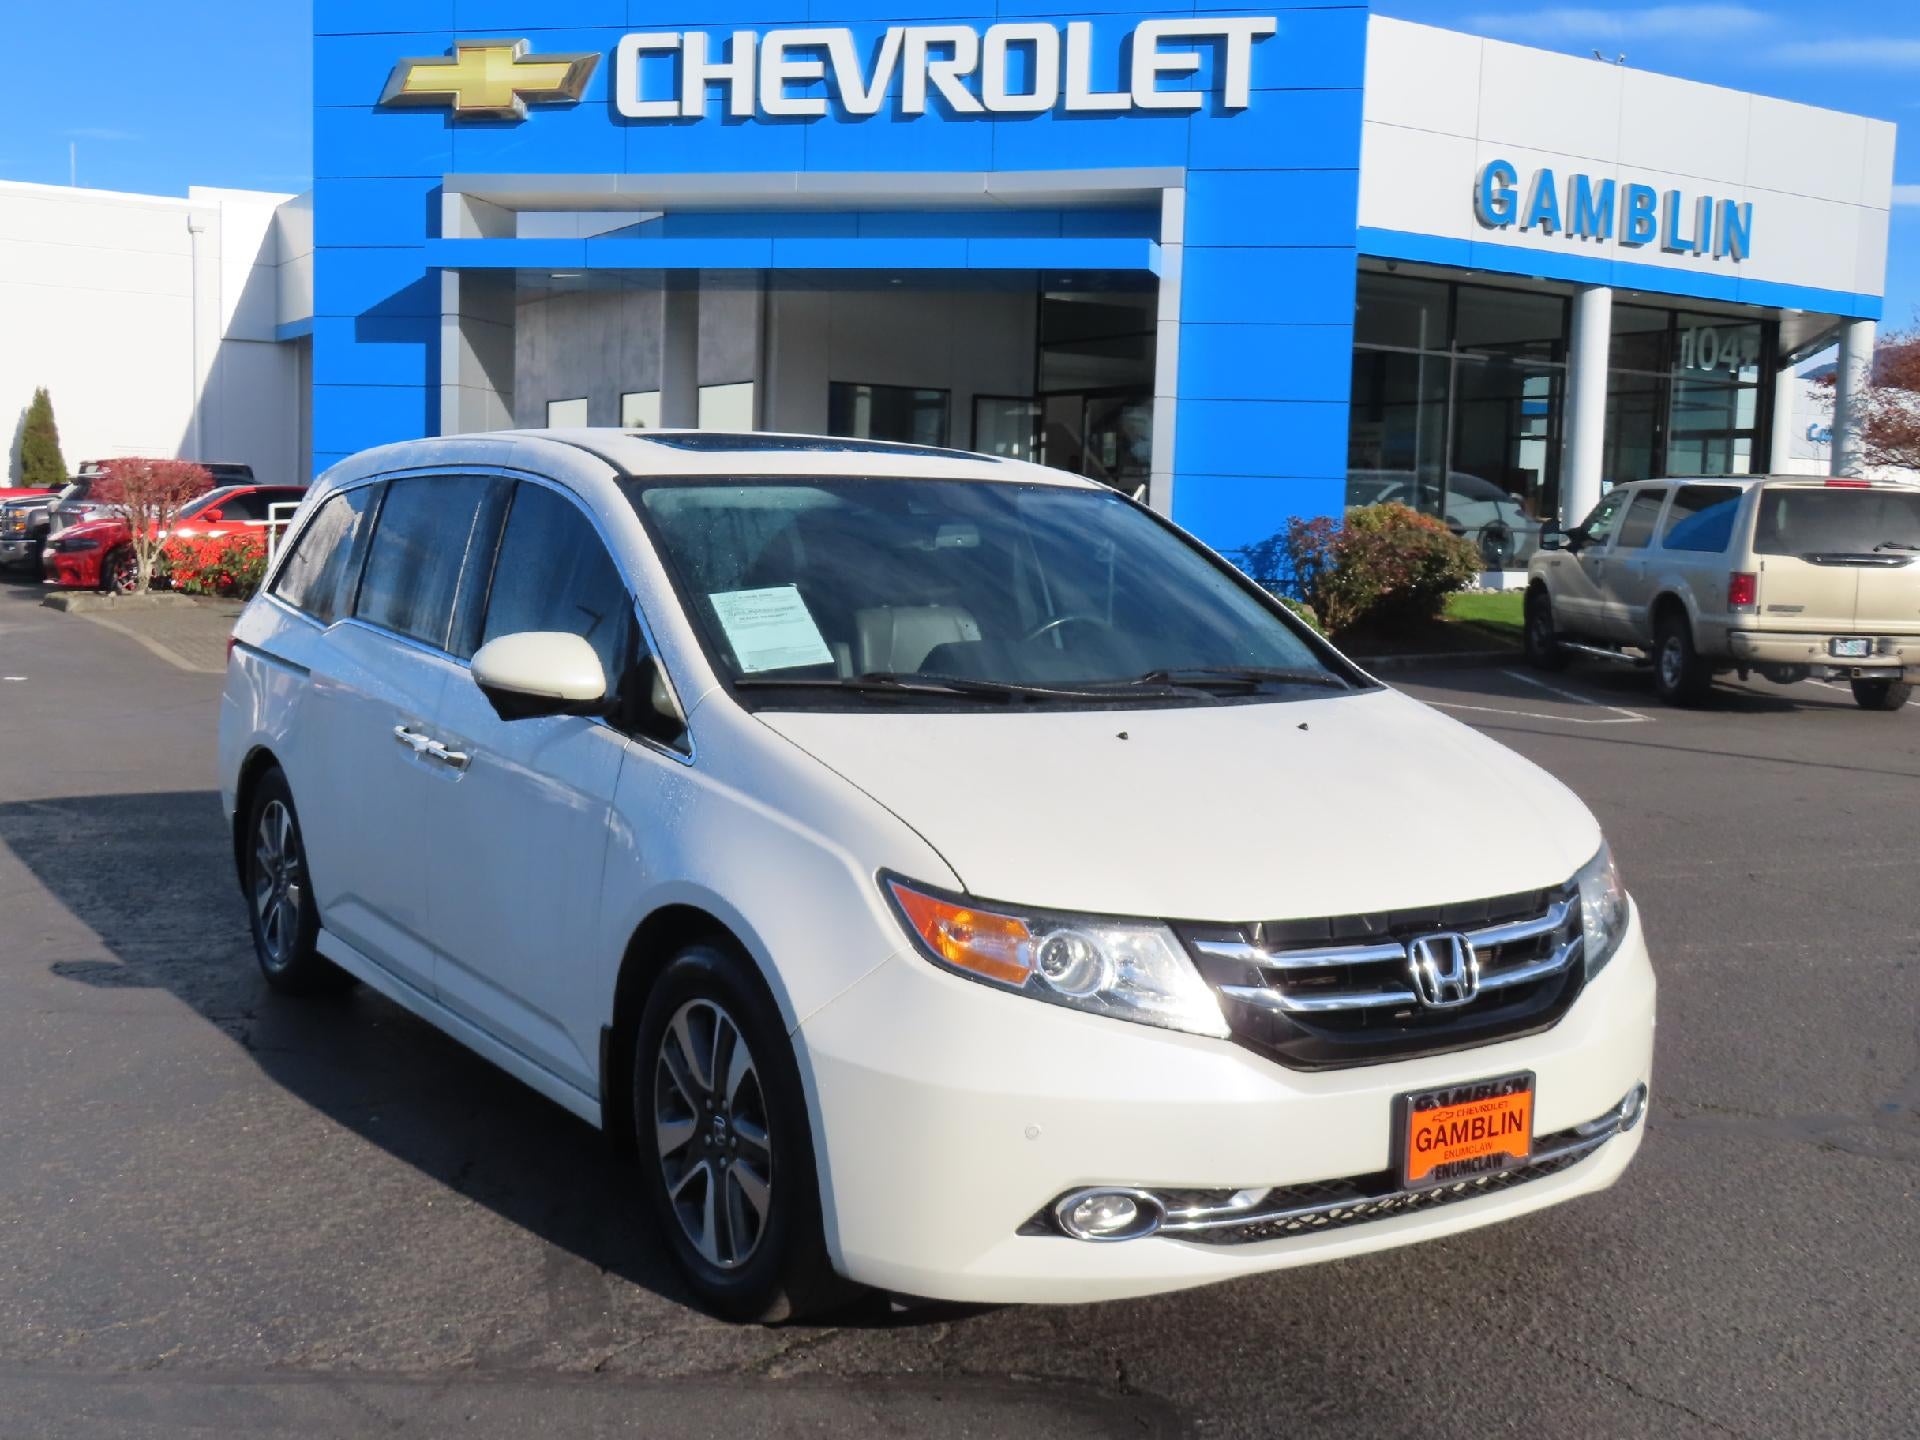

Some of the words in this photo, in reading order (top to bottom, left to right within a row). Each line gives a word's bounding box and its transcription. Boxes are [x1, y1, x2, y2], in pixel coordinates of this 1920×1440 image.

[616, 16, 1277, 118] CHEVROLET
[1473, 159, 1752, 263] GAMBLIN
[1415, 1108, 1523, 1152] GAMBLIN
[1456, 1101, 1509, 1118] CHEVROLET
[1443, 1142, 1493, 1160] ENUMCLAW
